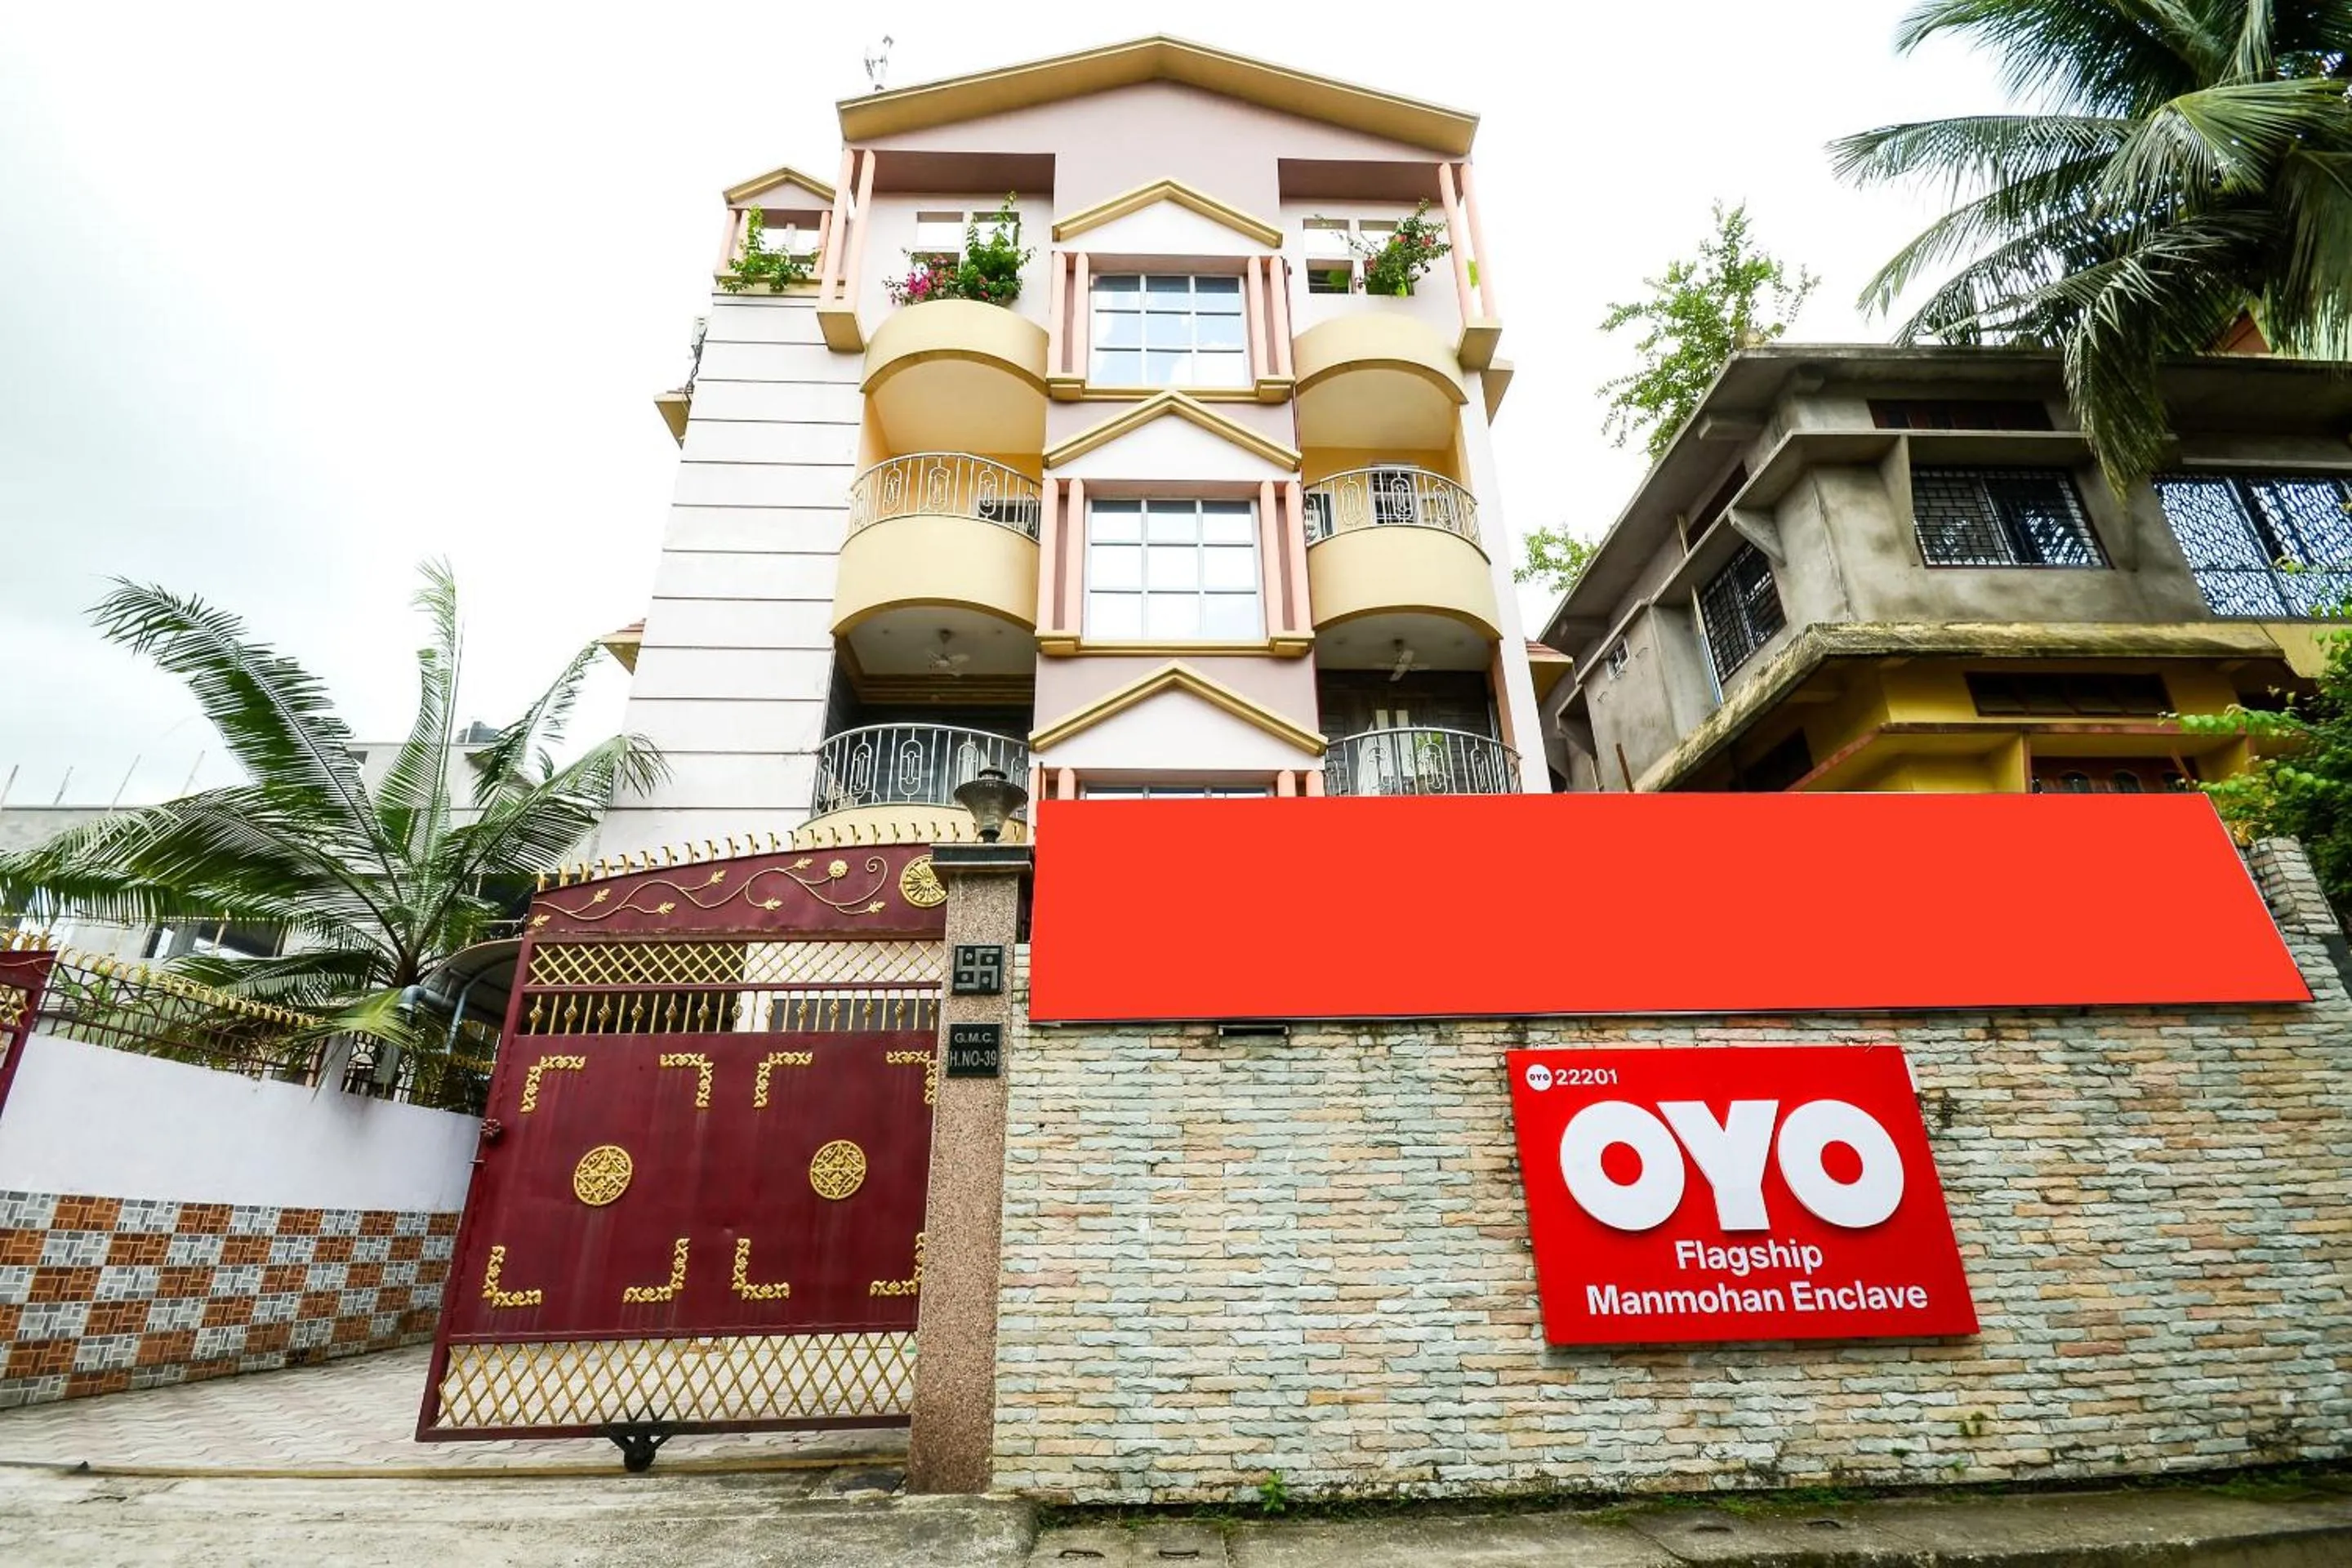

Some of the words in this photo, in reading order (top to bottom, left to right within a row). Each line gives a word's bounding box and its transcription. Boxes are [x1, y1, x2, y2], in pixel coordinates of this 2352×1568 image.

[954, 1032, 994, 1043] G.M.C.
[1529, 1073, 1550, 1081] OYO
[1555, 1068, 1619, 1085] 22201
[1559, 1099, 1905, 1231] OYO
[1675, 1238, 1823, 1277] Flagship
[1586, 1282, 1786, 1316] Manmohan
[1790, 1280, 1928, 1312] Enclave
